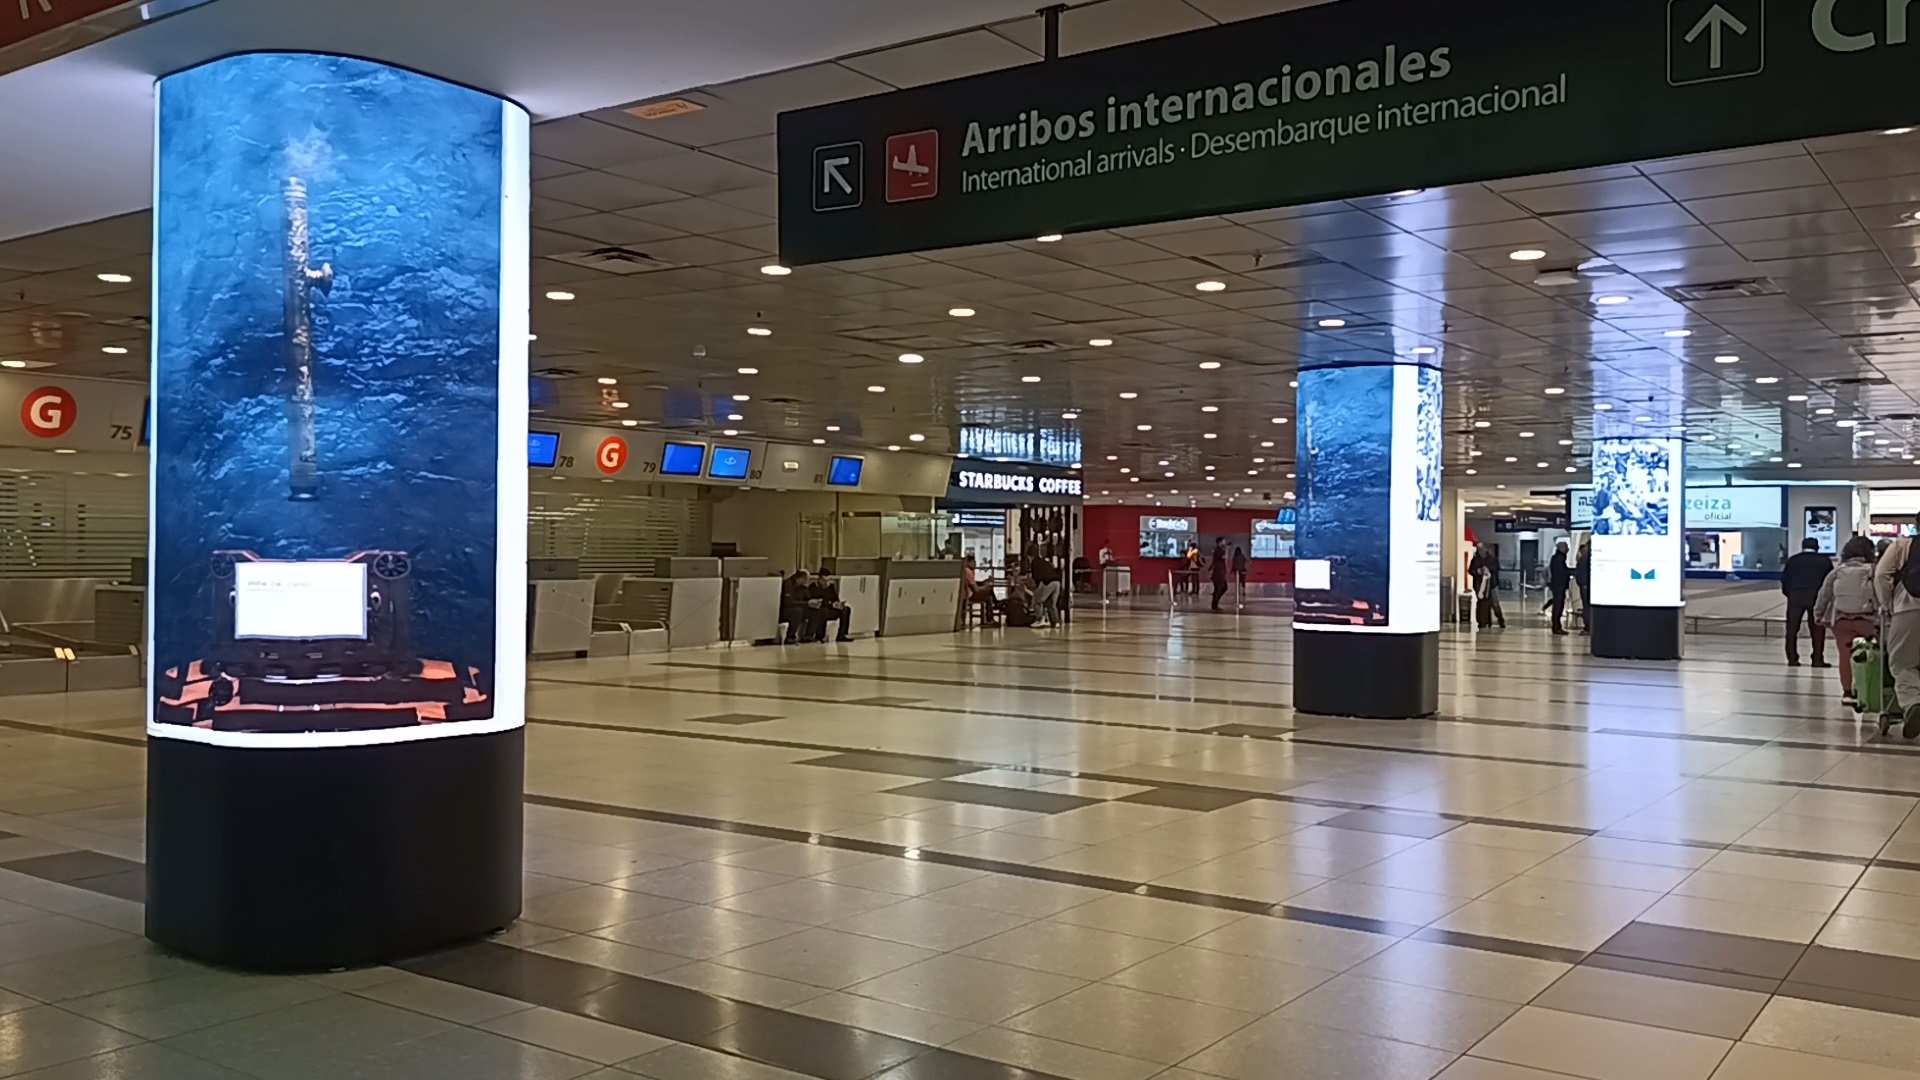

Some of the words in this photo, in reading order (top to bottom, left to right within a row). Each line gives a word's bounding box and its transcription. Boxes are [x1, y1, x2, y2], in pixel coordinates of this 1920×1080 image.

[961, 110, 1096, 158] Arribos
[1106, 44, 1452, 133] internacionales
[961, 150, 1092, 193] International
[1096, 139, 1175, 174] arrivals
[1190, 109, 1371, 162] Desembarque
[1376, 72, 1567, 132] internacional
[31, 395, 62, 429] G
[110, 424, 134, 441] 75
[559, 456, 575, 468] 78
[601, 443, 620, 468] G
[643, 462, 656, 473] 79
[750, 470, 762, 480] 80
[959, 470, 1034, 492] STARBUCKS
[1038, 477, 1082, 495] COFFEE
